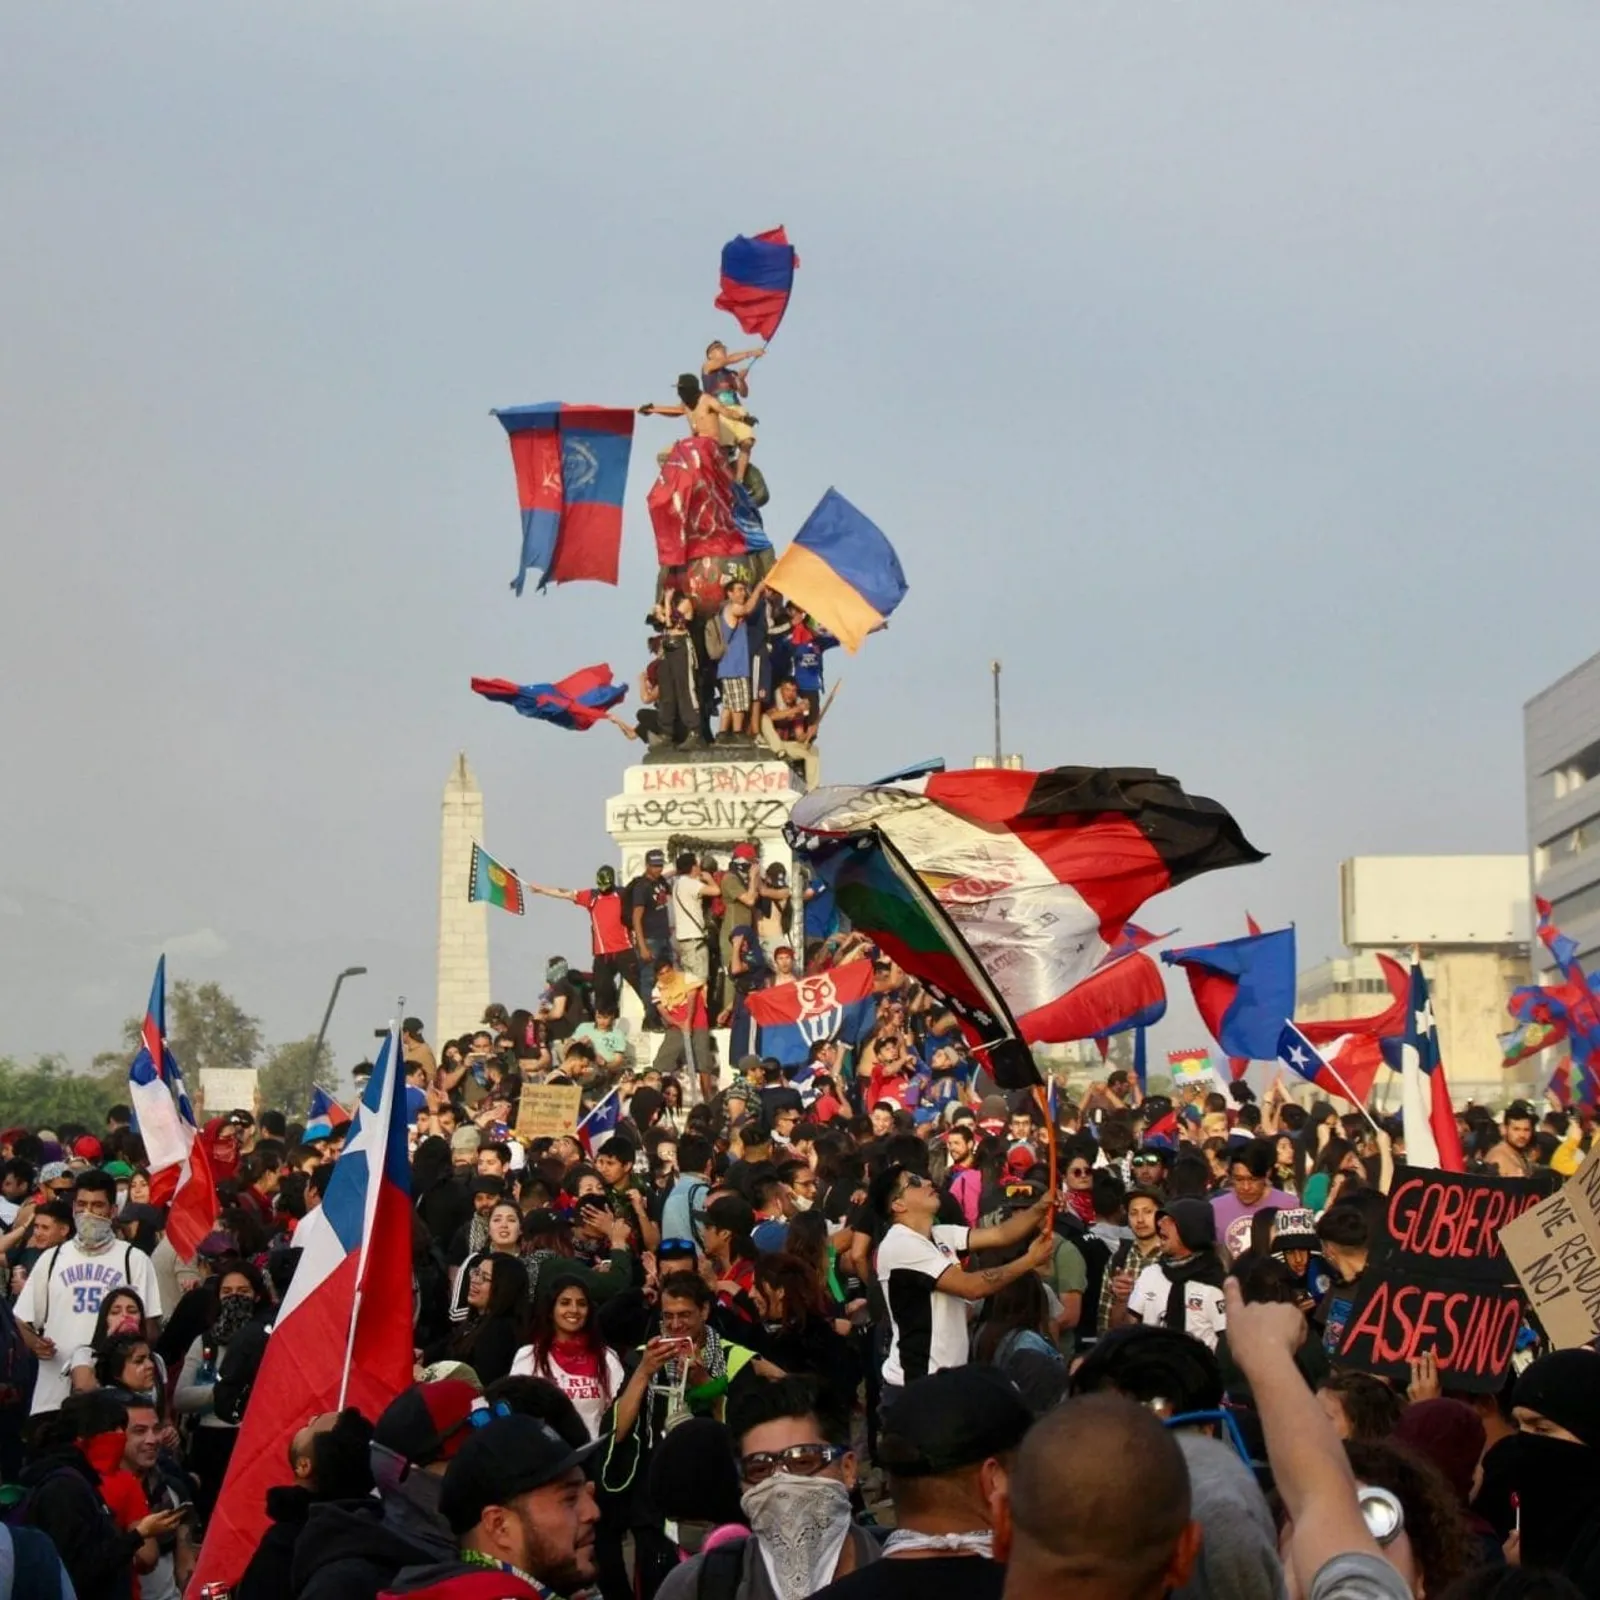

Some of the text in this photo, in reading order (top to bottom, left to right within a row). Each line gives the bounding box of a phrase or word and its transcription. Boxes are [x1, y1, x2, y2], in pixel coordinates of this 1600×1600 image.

[808, 1010, 831, 1042] U
[1536, 1196, 1576, 1238] ME
[60, 1263, 123, 1288] THUNDER
[1522, 1253, 1570, 1306] NO!
[73, 1287, 101, 1313] 35
[1341, 1281, 1522, 1377] ASESINO
